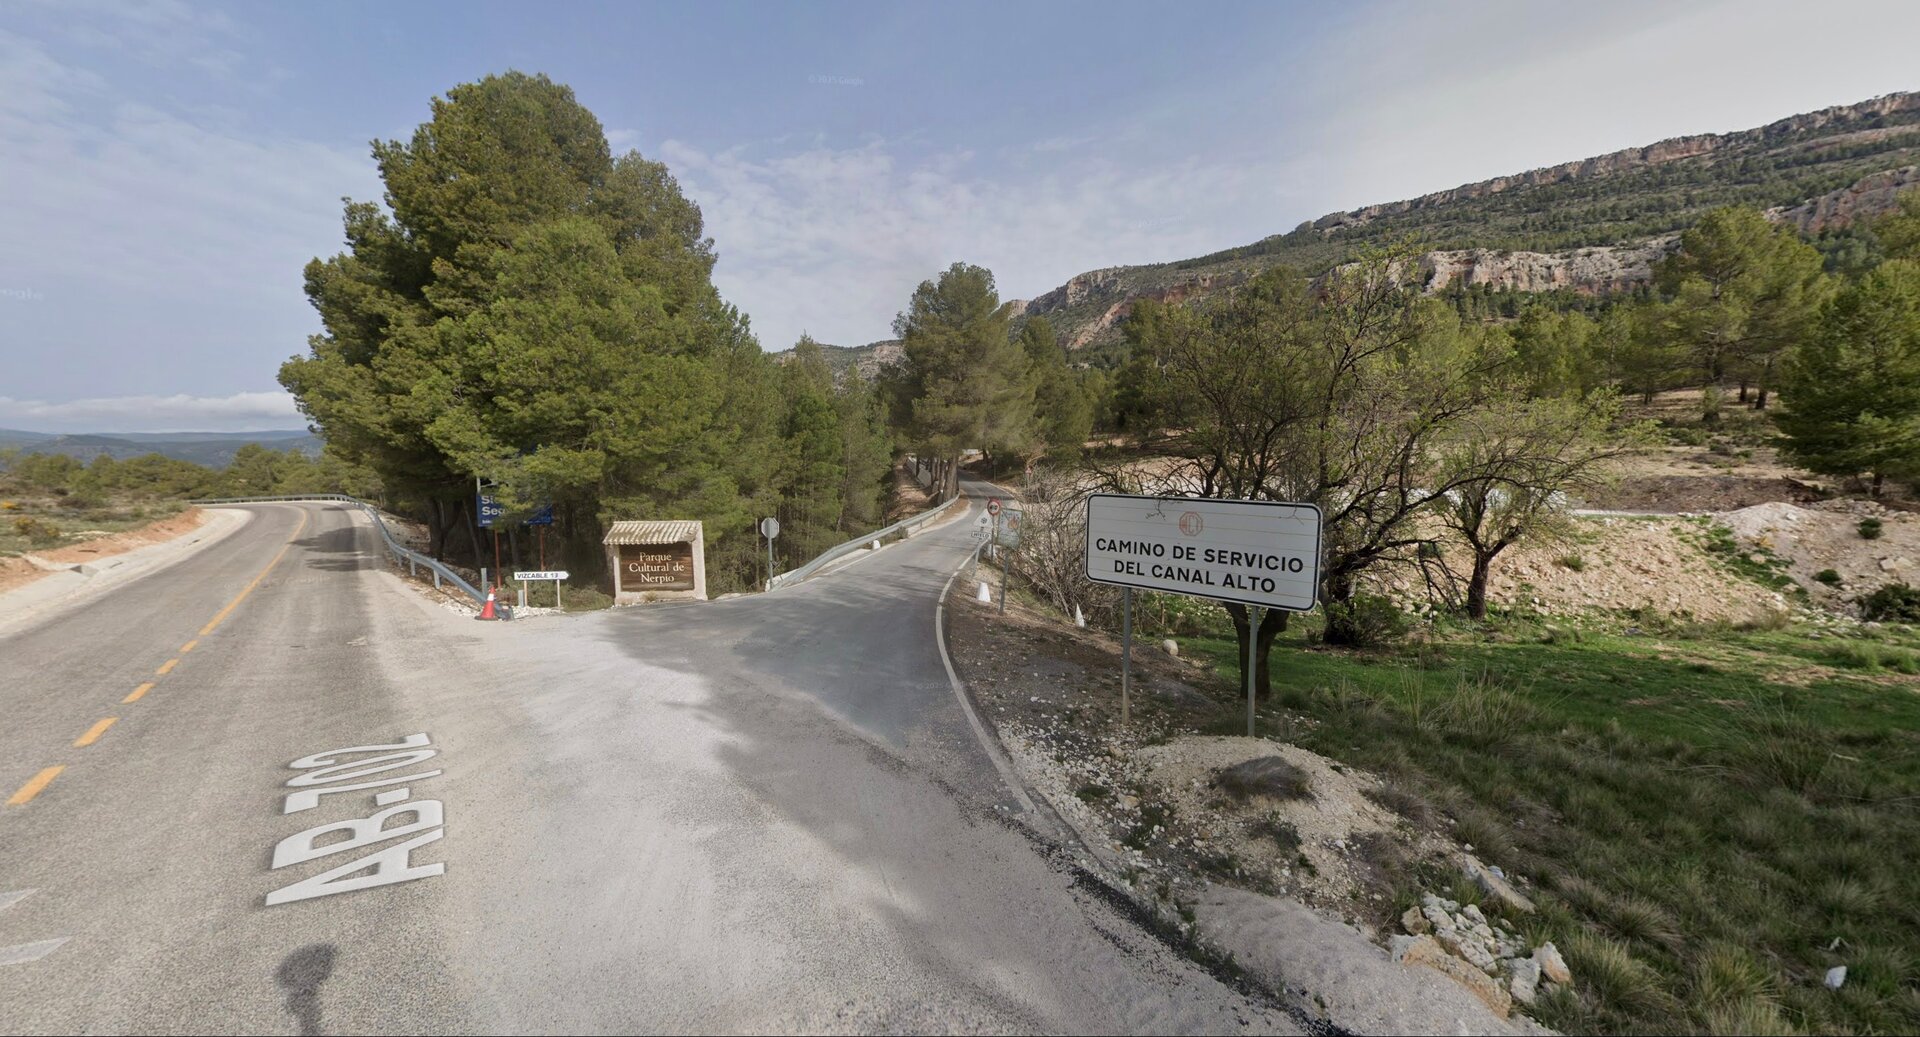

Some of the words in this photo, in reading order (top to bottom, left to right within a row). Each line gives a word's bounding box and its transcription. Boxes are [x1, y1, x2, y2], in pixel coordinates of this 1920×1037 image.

[640, 552, 672, 563] Parque
[1096, 538, 1165, 557] CAMINO
[1173, 545, 1196, 561] DE
[1204, 548, 1303, 573] SERVICIO
[629, 562, 669, 572] Cultural
[673, 562, 685, 571] de
[1114, 560, 1145, 576] DEL
[1151, 564, 1215, 586] CANAL
[1222, 573, 1276, 593] ALTO
[641, 573, 675, 584] Nerpio
[266, 732, 444, 906] AB-702
